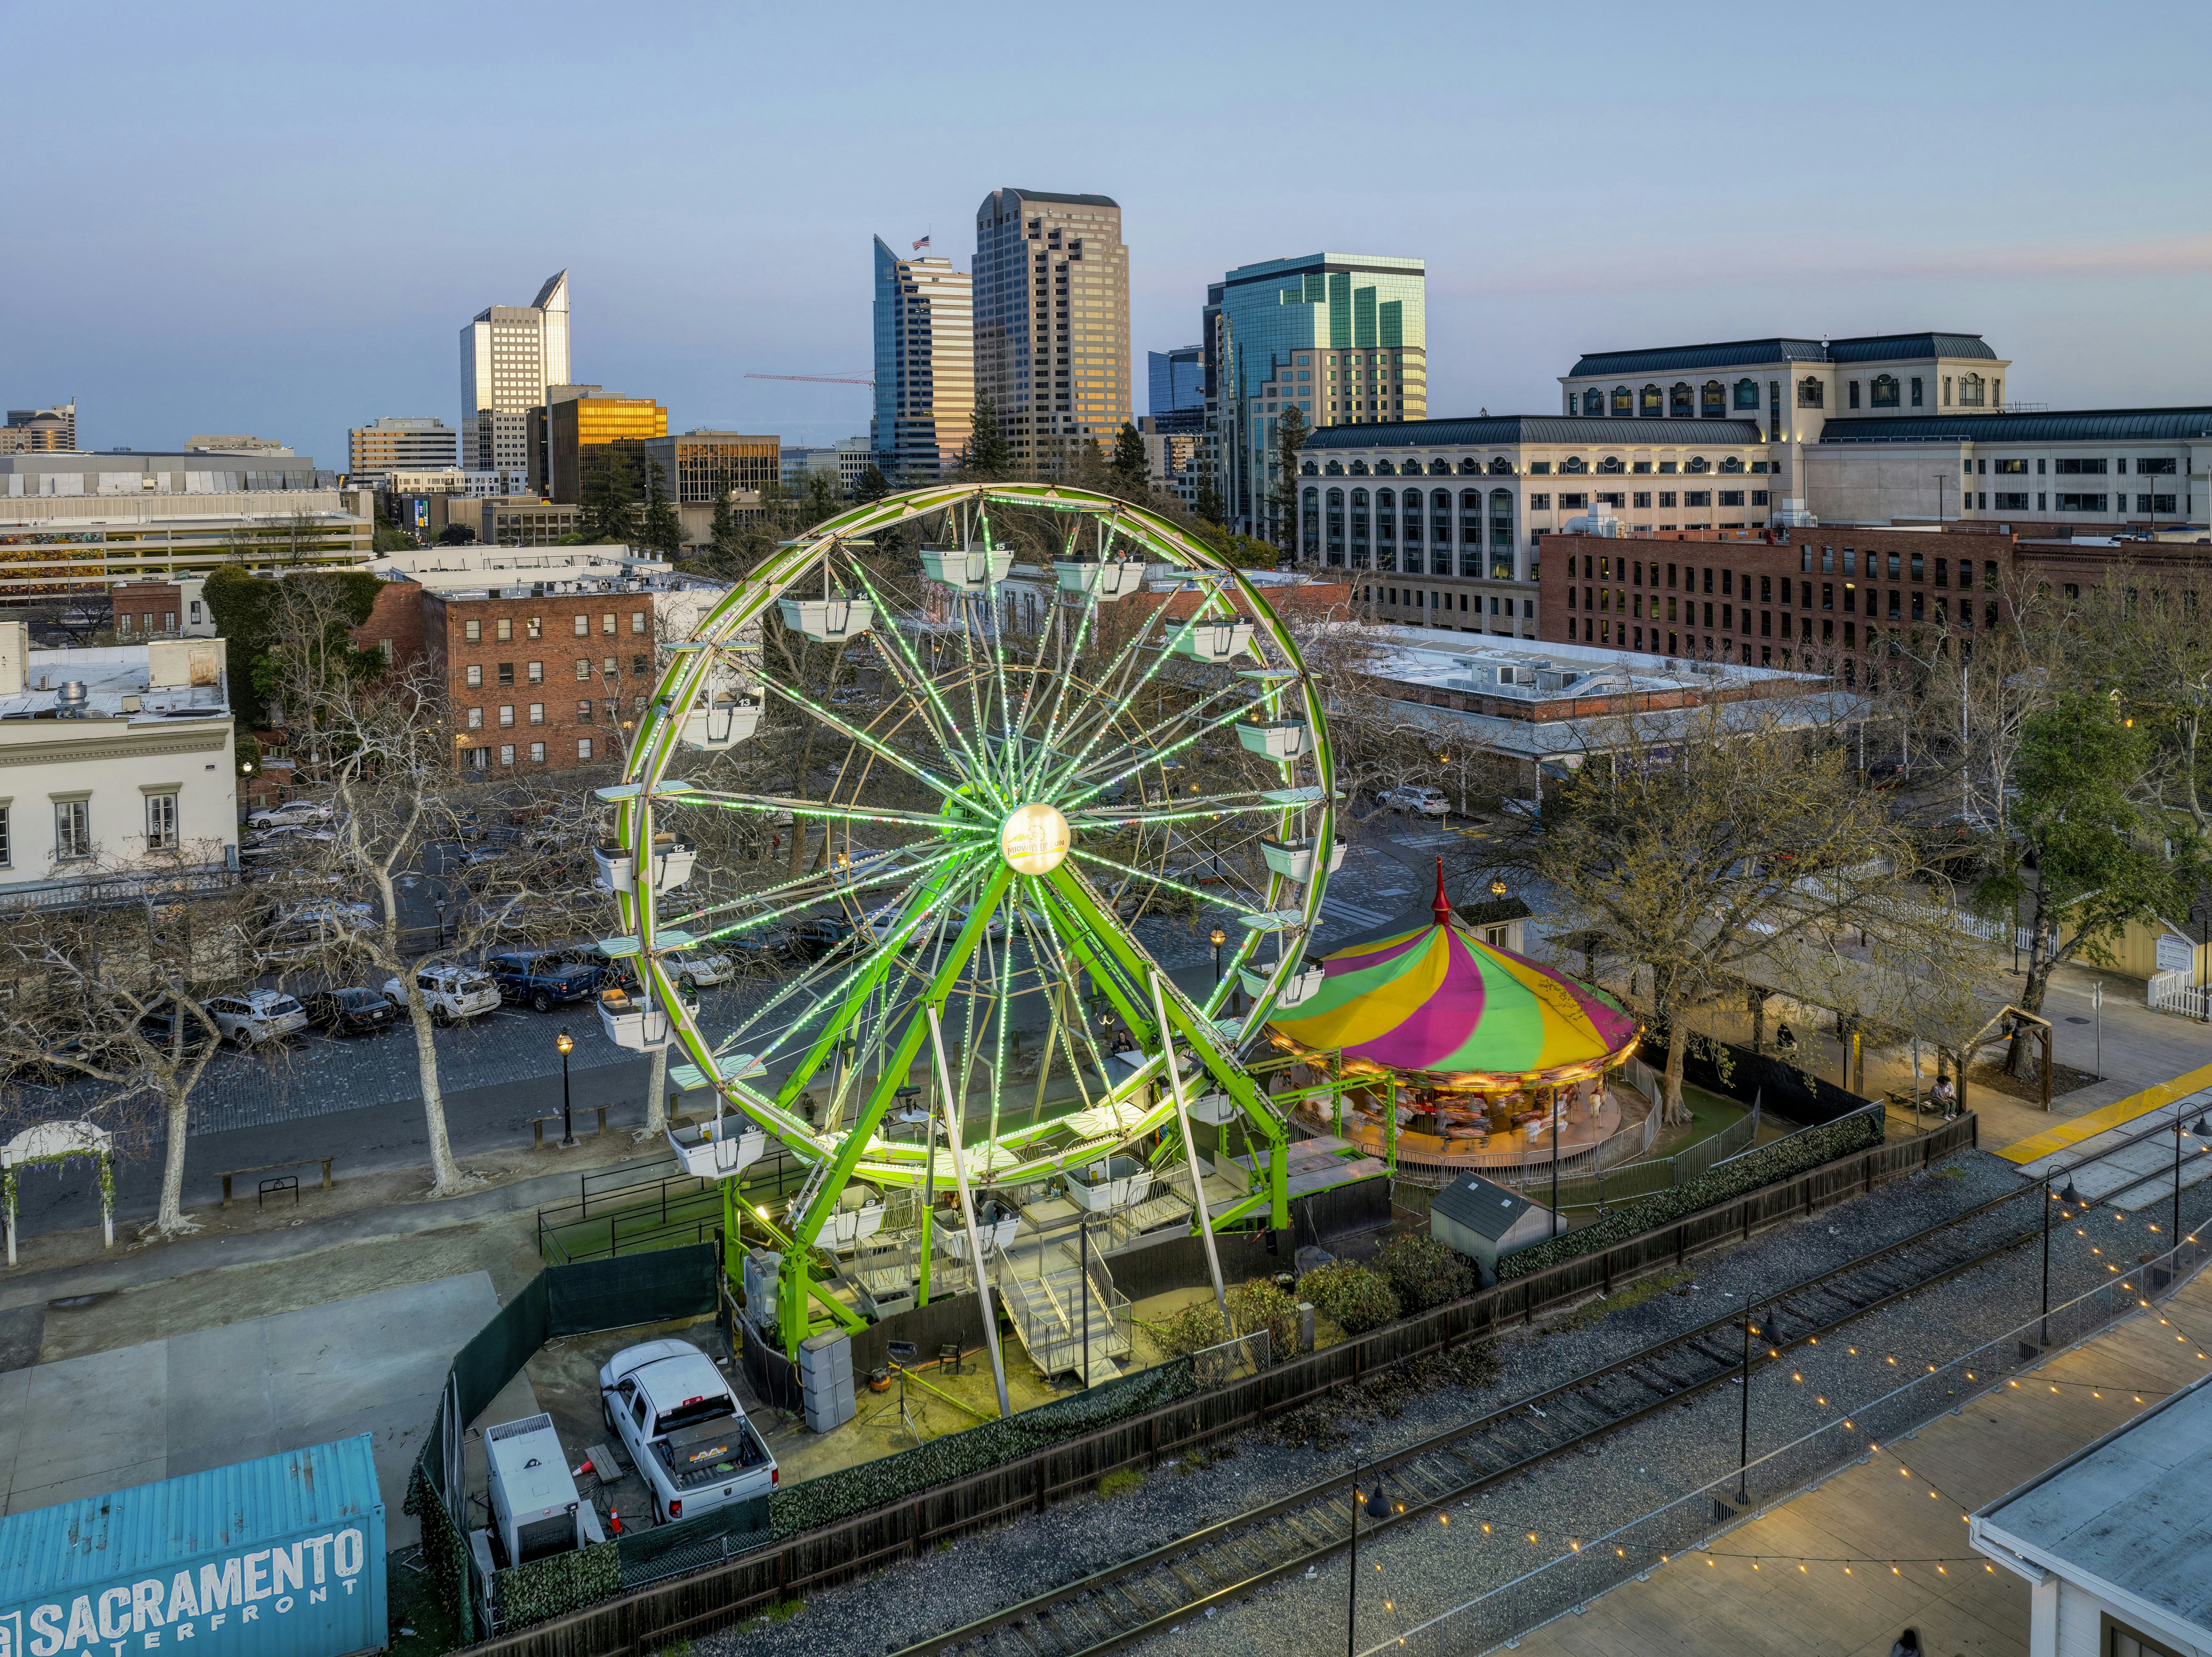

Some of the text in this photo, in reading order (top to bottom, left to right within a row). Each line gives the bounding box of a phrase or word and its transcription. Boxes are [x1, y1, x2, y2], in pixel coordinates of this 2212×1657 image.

[739, 698, 751, 706] 13
[673, 844, 685, 853] 12
[1007, 844, 1037, 856] MIDWAY
[1040, 842, 1048, 851] OF
[745, 1125, 756, 1133] 10
[30, 1528, 364, 1657] SACRAMENTO
